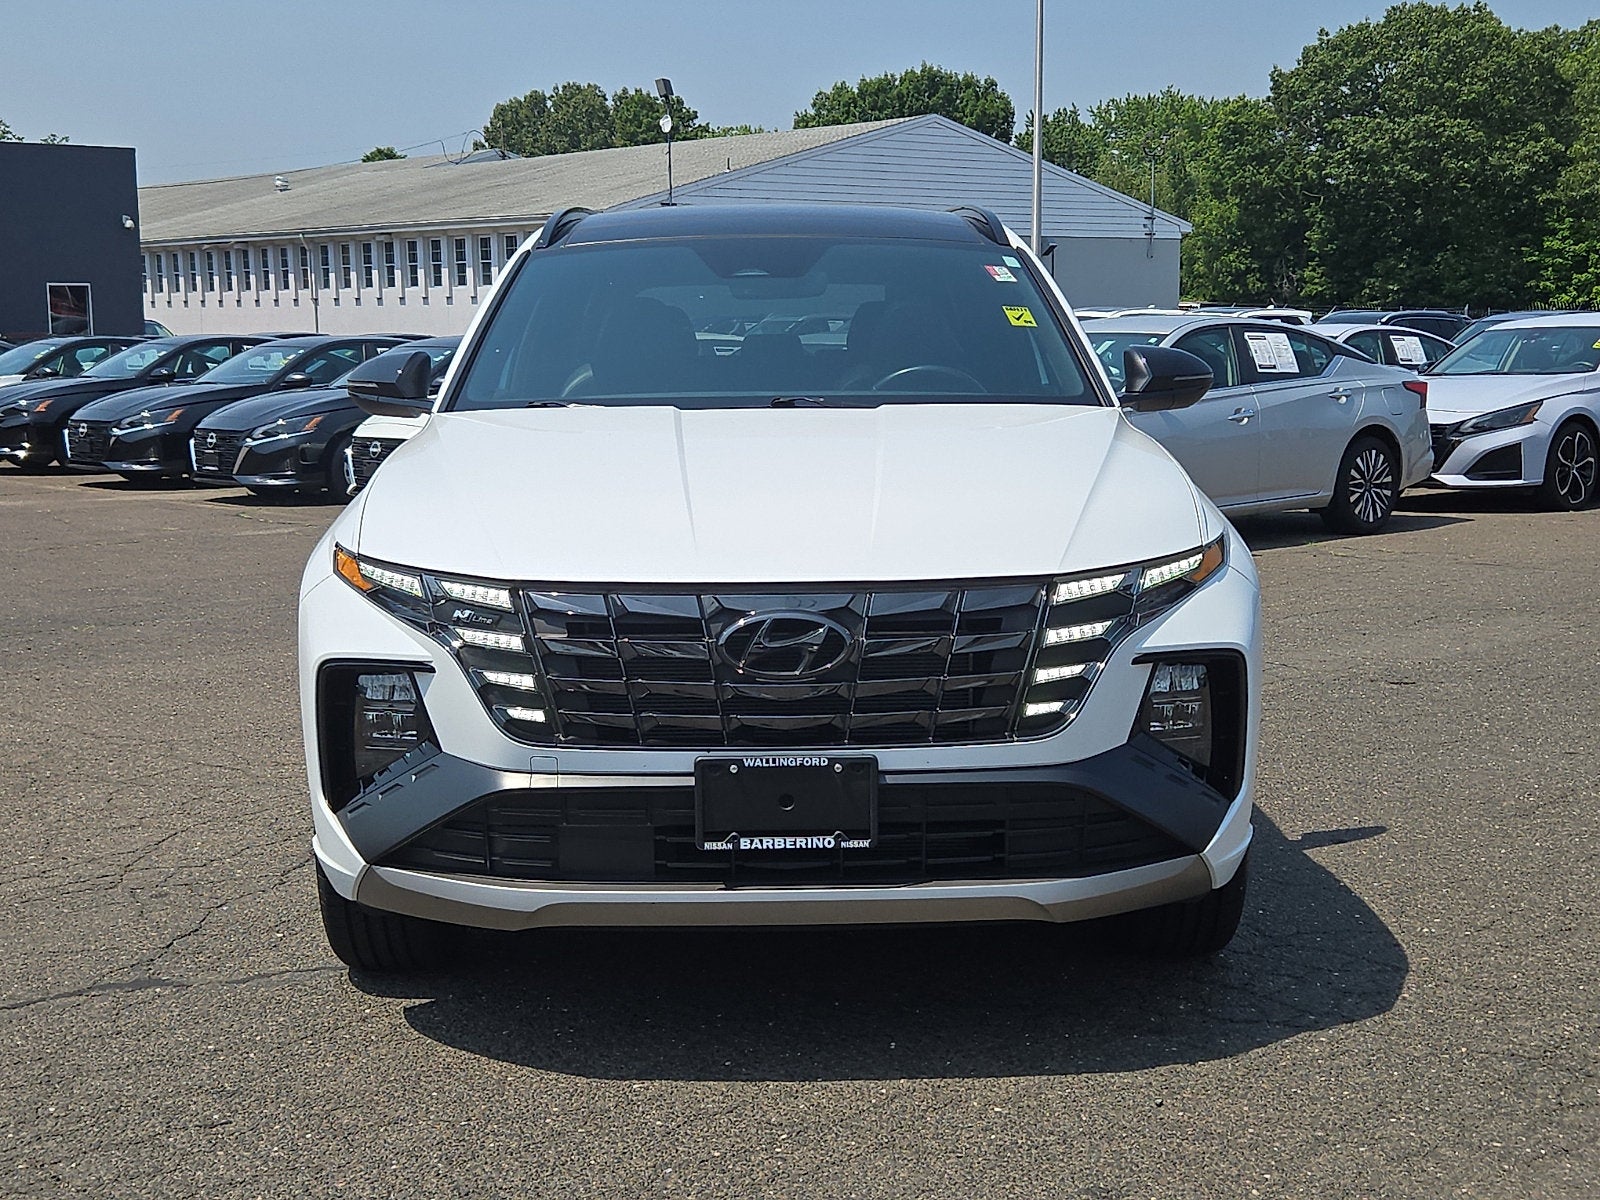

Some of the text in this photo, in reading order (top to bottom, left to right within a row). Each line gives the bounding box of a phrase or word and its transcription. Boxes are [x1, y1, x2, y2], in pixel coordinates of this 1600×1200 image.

[742, 757, 829, 767] WALLINGFORD
[704, 837, 870, 850] NISSAN BARBERINO NISSAN
